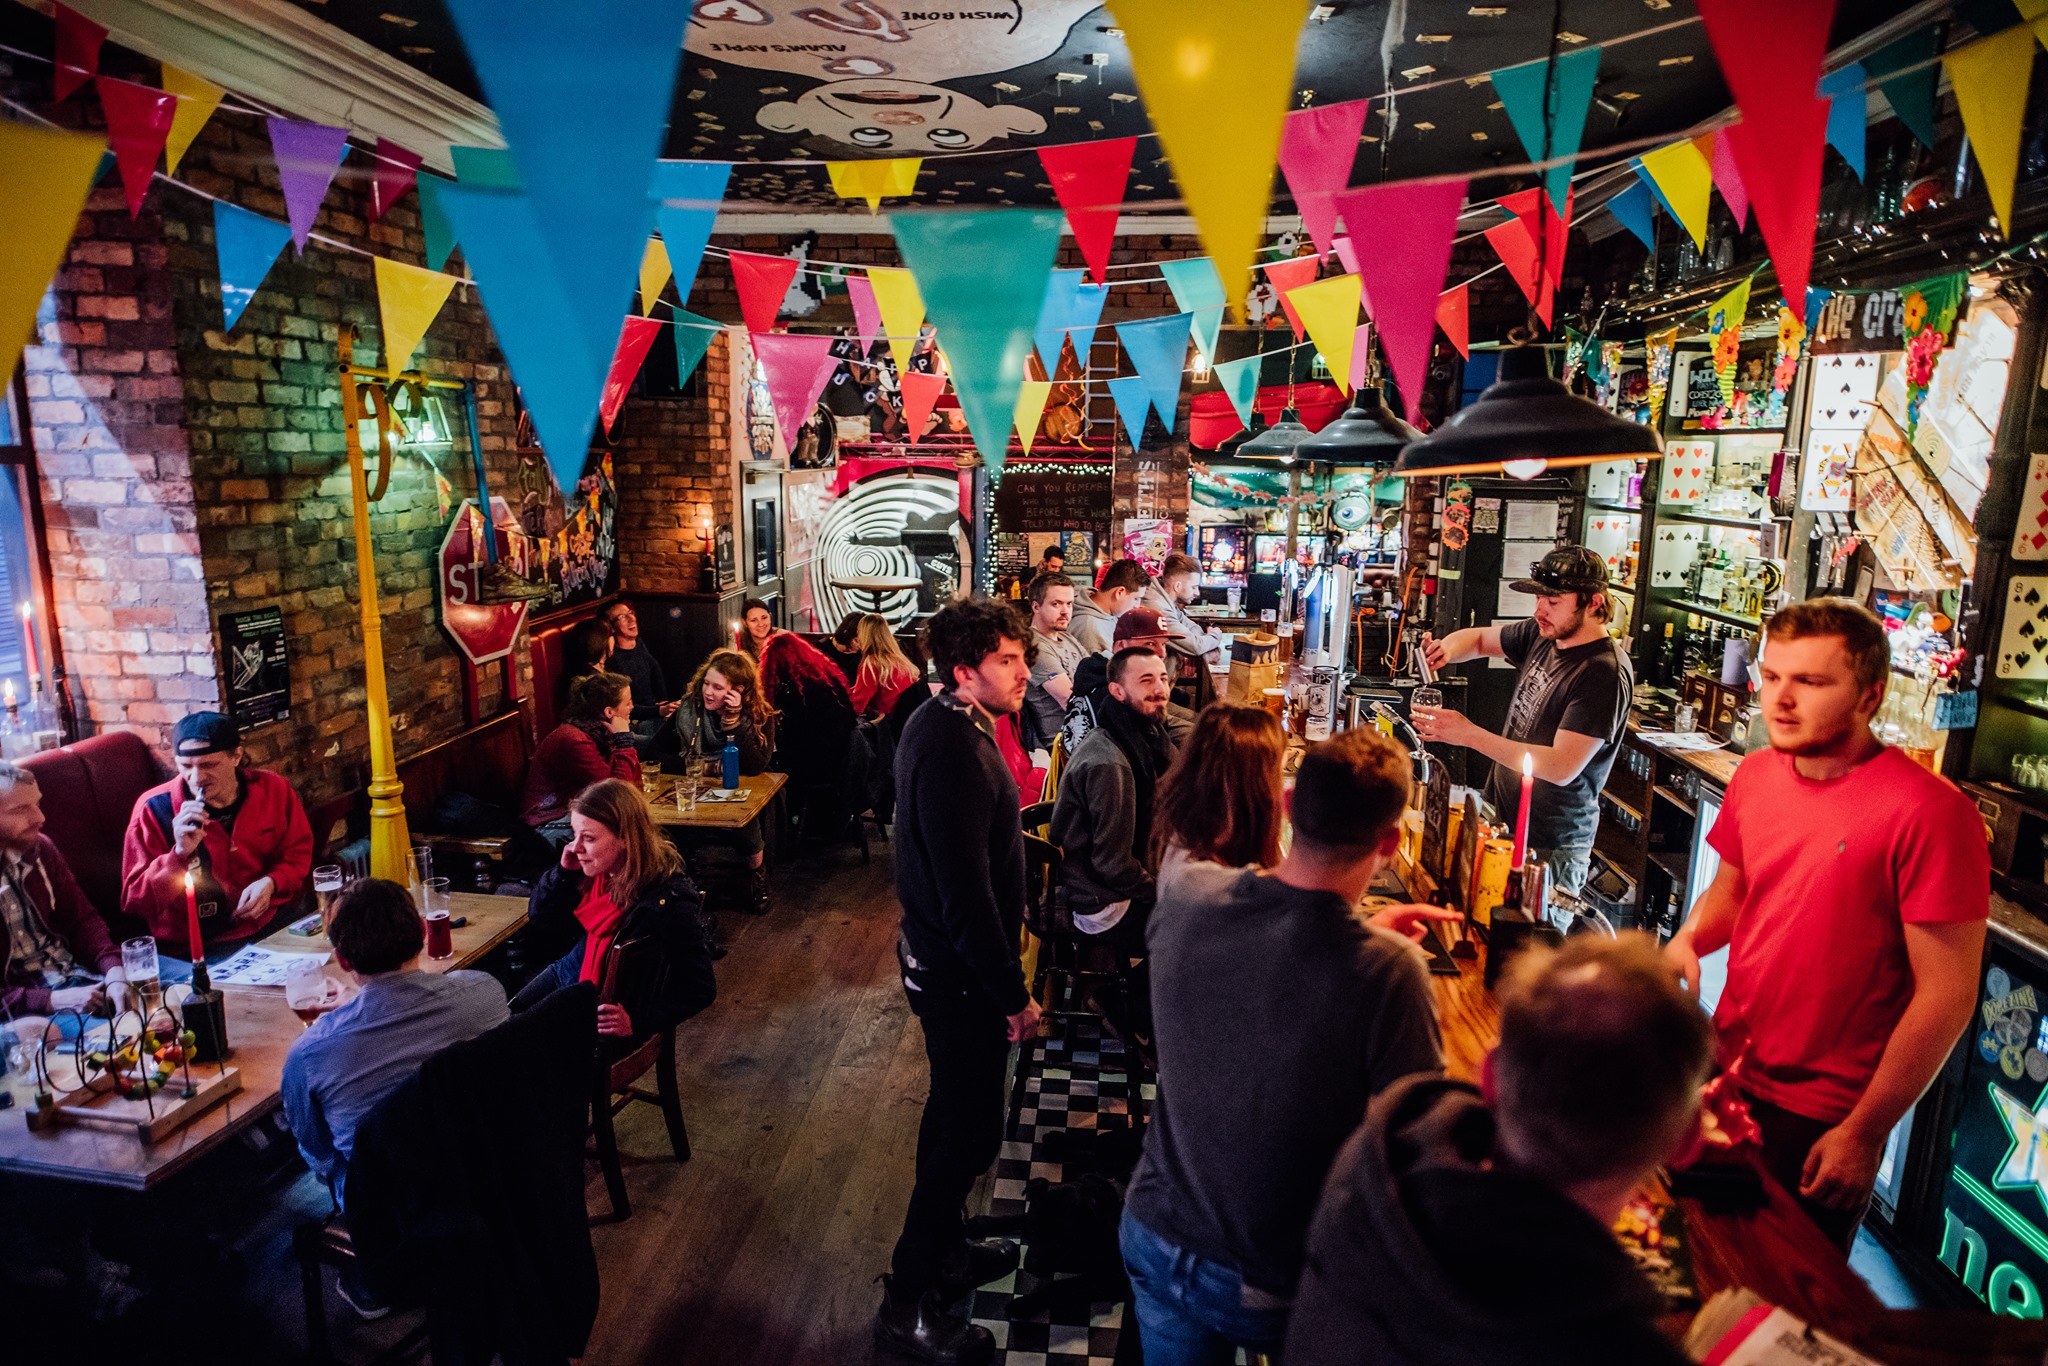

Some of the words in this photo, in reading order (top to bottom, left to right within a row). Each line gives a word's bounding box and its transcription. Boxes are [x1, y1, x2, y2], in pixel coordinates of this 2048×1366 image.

[901, 10, 955, 21] BONE
[958, 10, 1014, 21] WISH
[711, 43, 768, 53] APPLE
[769, 43, 846, 53] ADAM'S
[1017, 484, 1036, 493] CAN
[1043, 484, 1061, 493] YOU
[1065, 483, 1112, 493] REMEMBE
[1026, 508, 1061, 518] BEFORE
[1068, 508, 1085, 517] THE
[1063, 519, 1080, 529] WHO
[1083, 520, 1092, 530] TO
